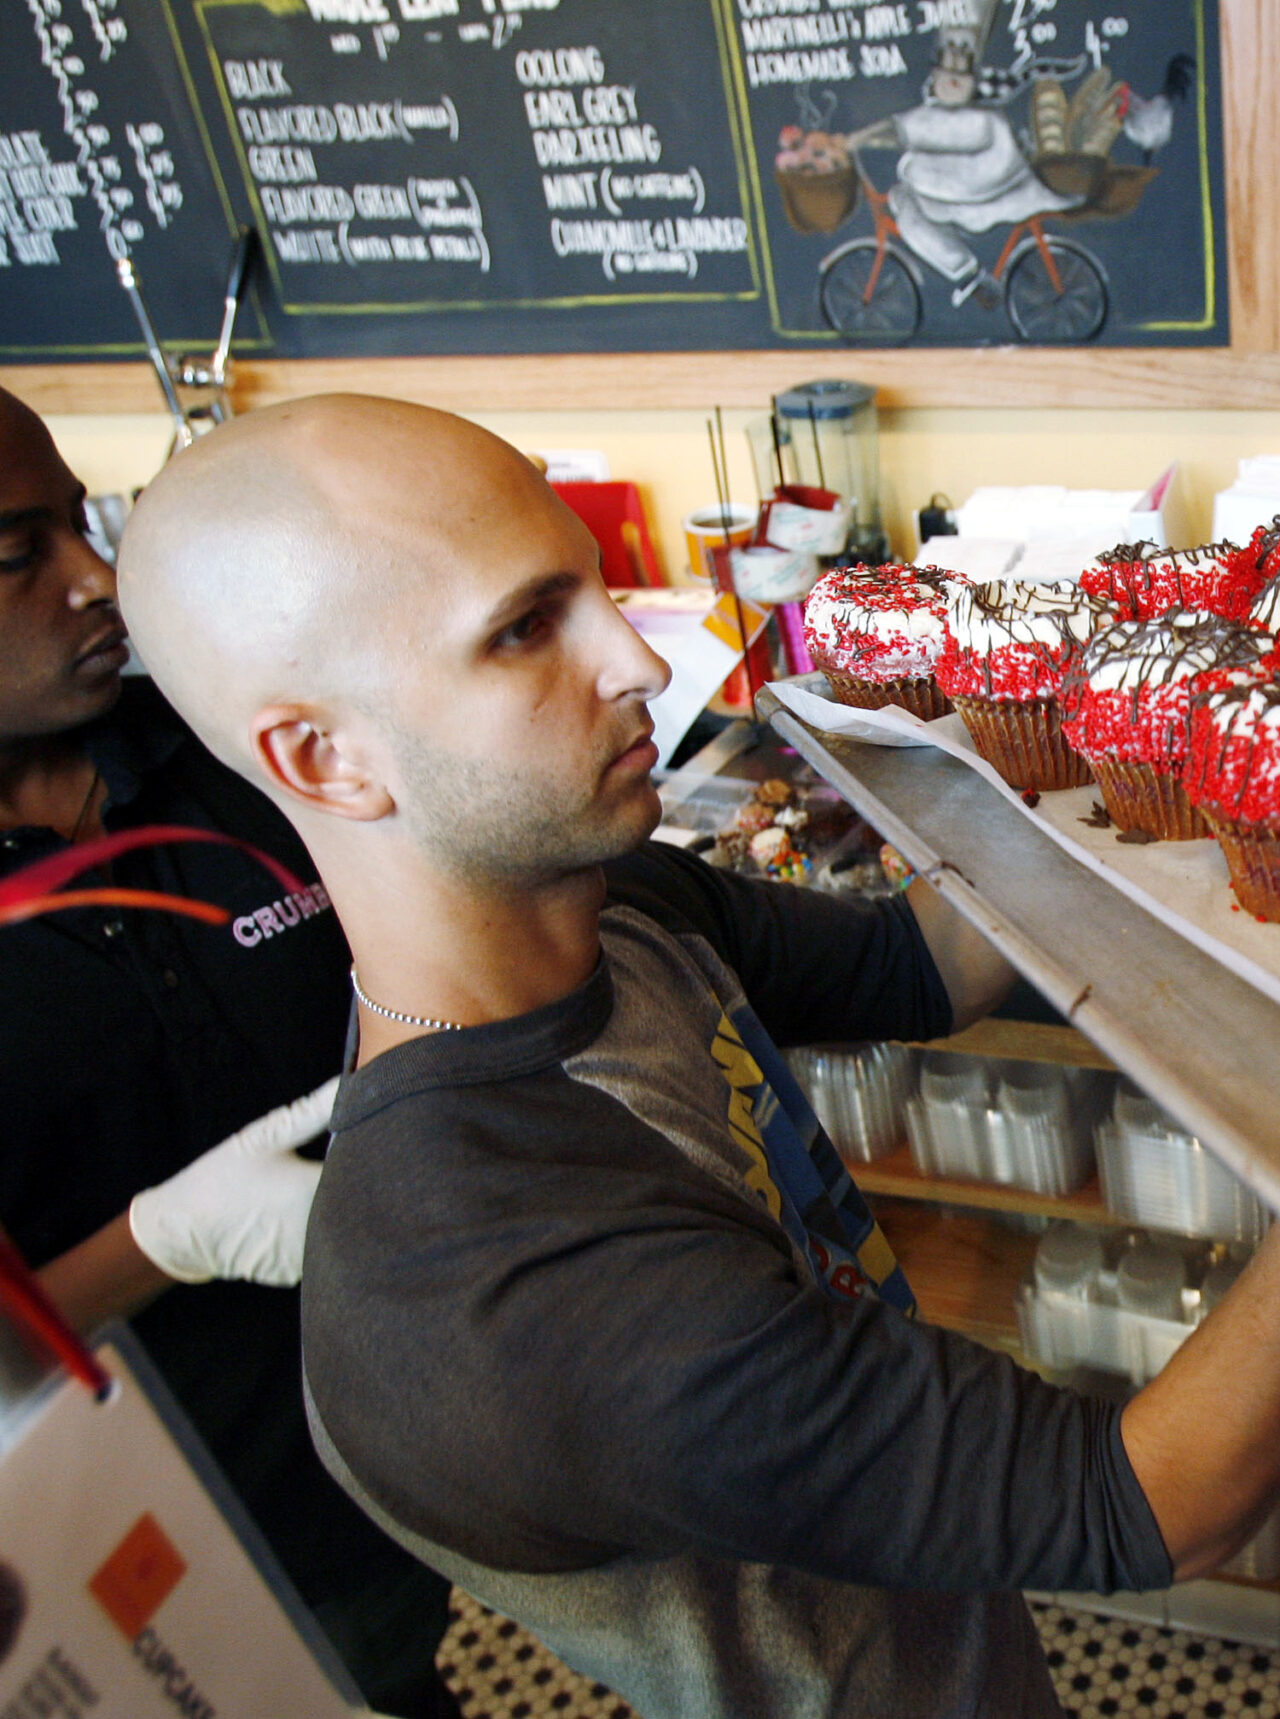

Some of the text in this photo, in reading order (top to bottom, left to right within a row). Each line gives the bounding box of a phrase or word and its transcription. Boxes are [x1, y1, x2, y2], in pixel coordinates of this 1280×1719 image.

[224, 59, 292, 100] BLACK
[515, 46, 604, 87] OOLONG
[859, 43, 909, 79] SODA
[237, 104, 338, 144] FLAVORED
[523, 83, 638, 129] EARL GREY
[249, 145, 318, 182] GREEN
[533, 123, 661, 167] DARJEELING
[260, 185, 356, 225] FLAVORED
[353, 182, 412, 220] GREEN
[542, 171, 597, 210] MINT
